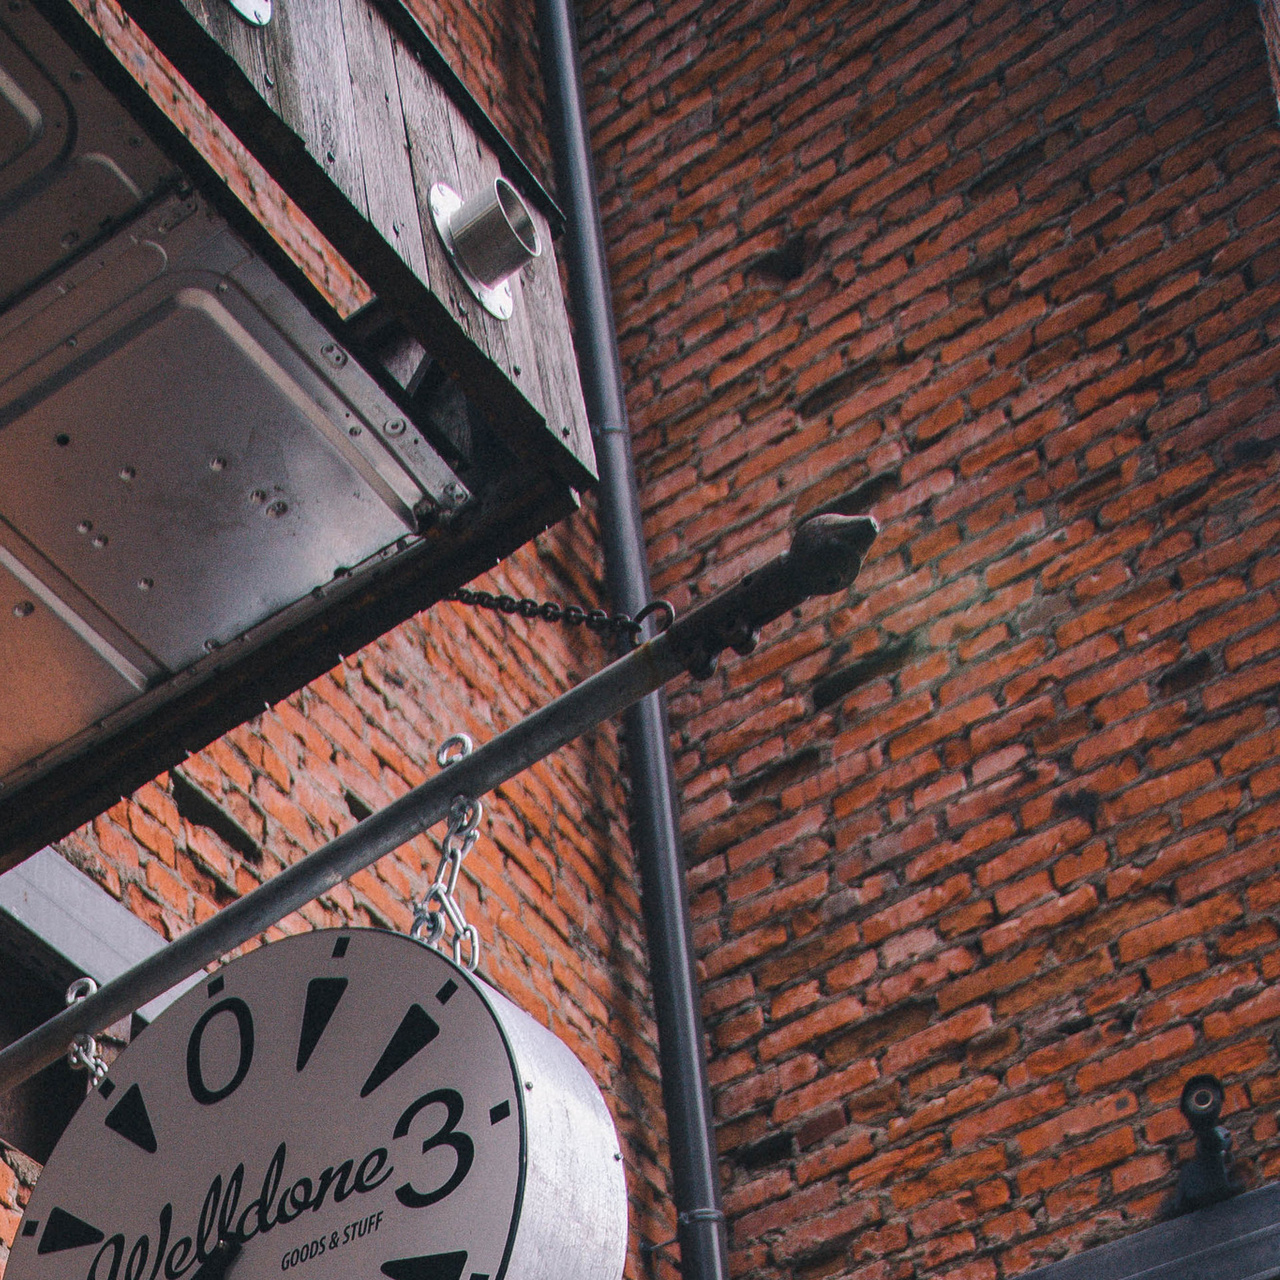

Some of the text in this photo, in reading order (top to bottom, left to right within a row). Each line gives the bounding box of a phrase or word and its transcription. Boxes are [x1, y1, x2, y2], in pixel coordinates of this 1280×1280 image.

[392, 1088, 475, 1209] 3
[281, 1210, 384, 1271] GOODS & STUFF
